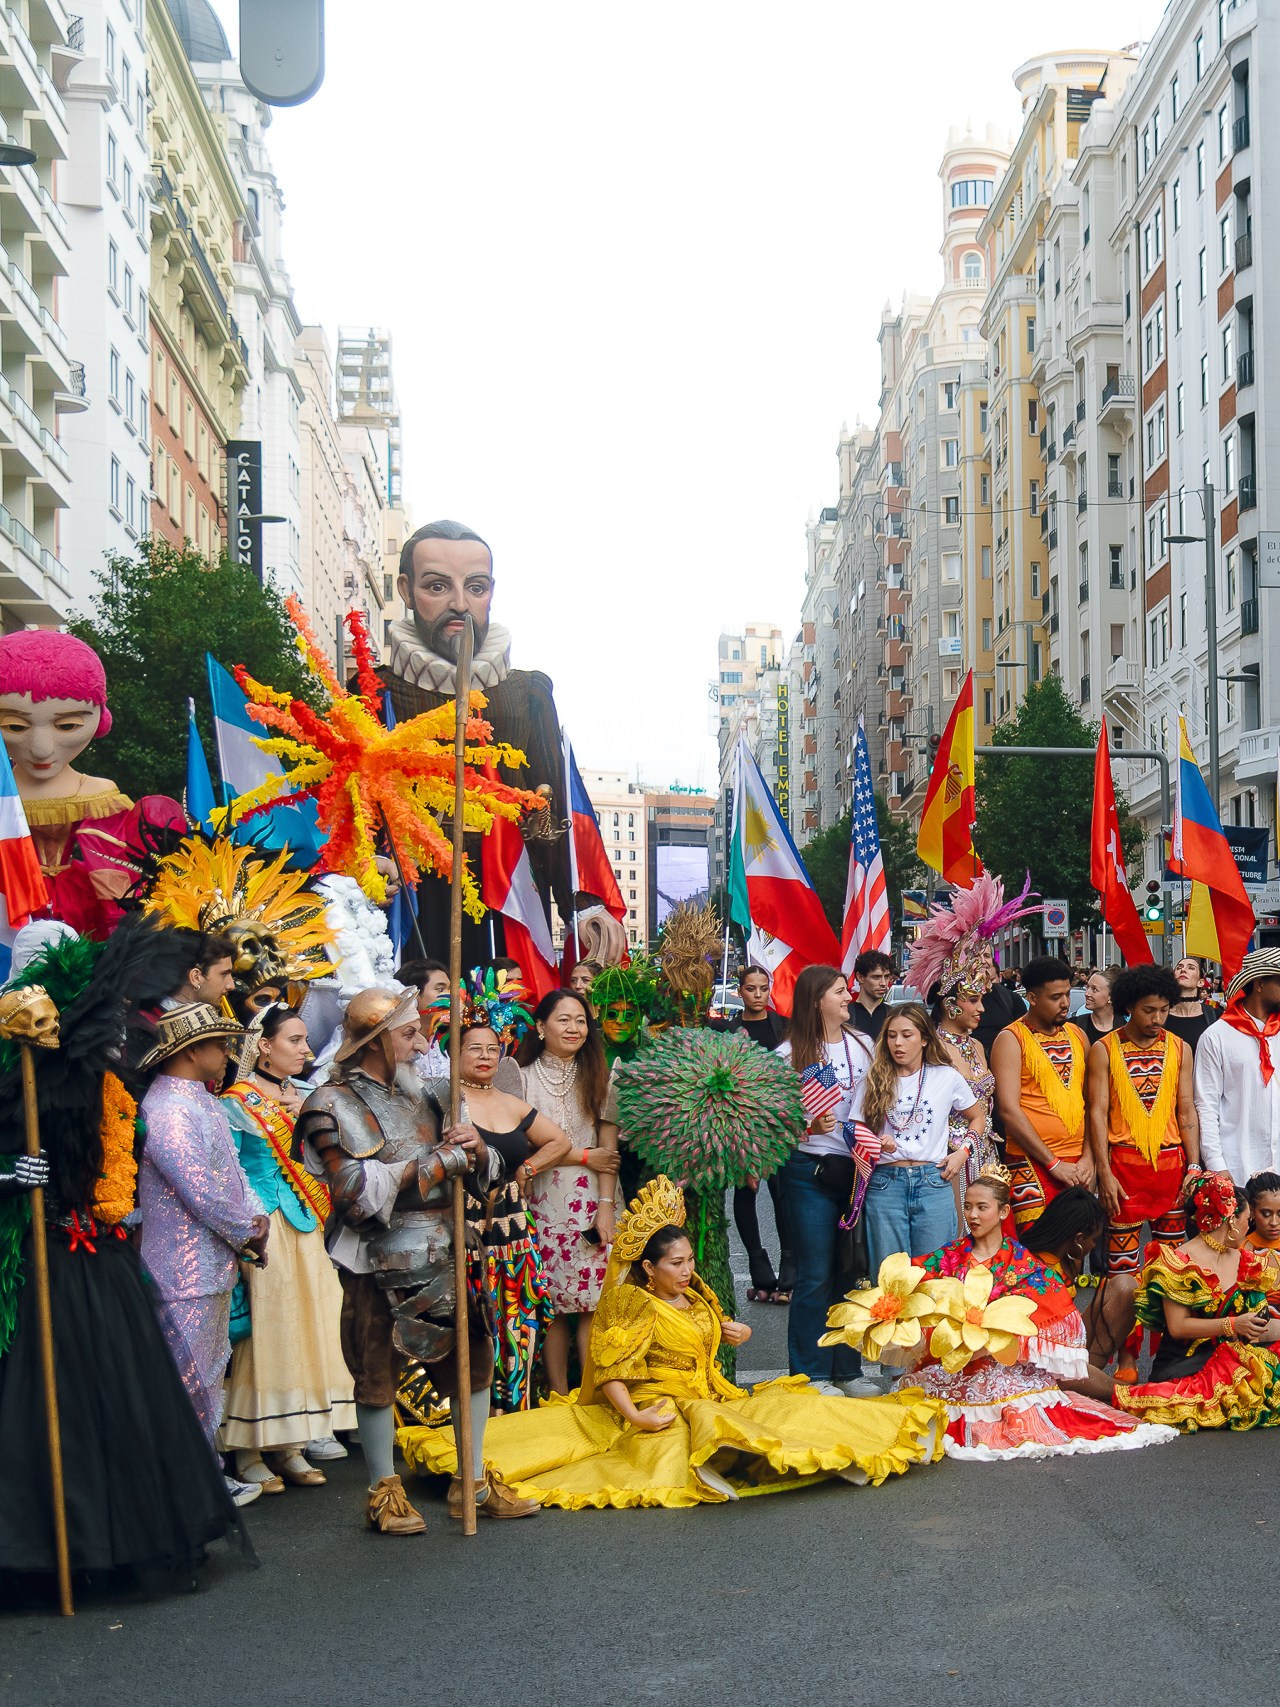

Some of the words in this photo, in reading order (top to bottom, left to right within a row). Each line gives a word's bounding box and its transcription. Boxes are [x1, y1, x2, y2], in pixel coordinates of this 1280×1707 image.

[1267, 542, 1276, 550] El
[1266, 555, 1275, 564] de
[777, 685, 789, 757] HOTEL
